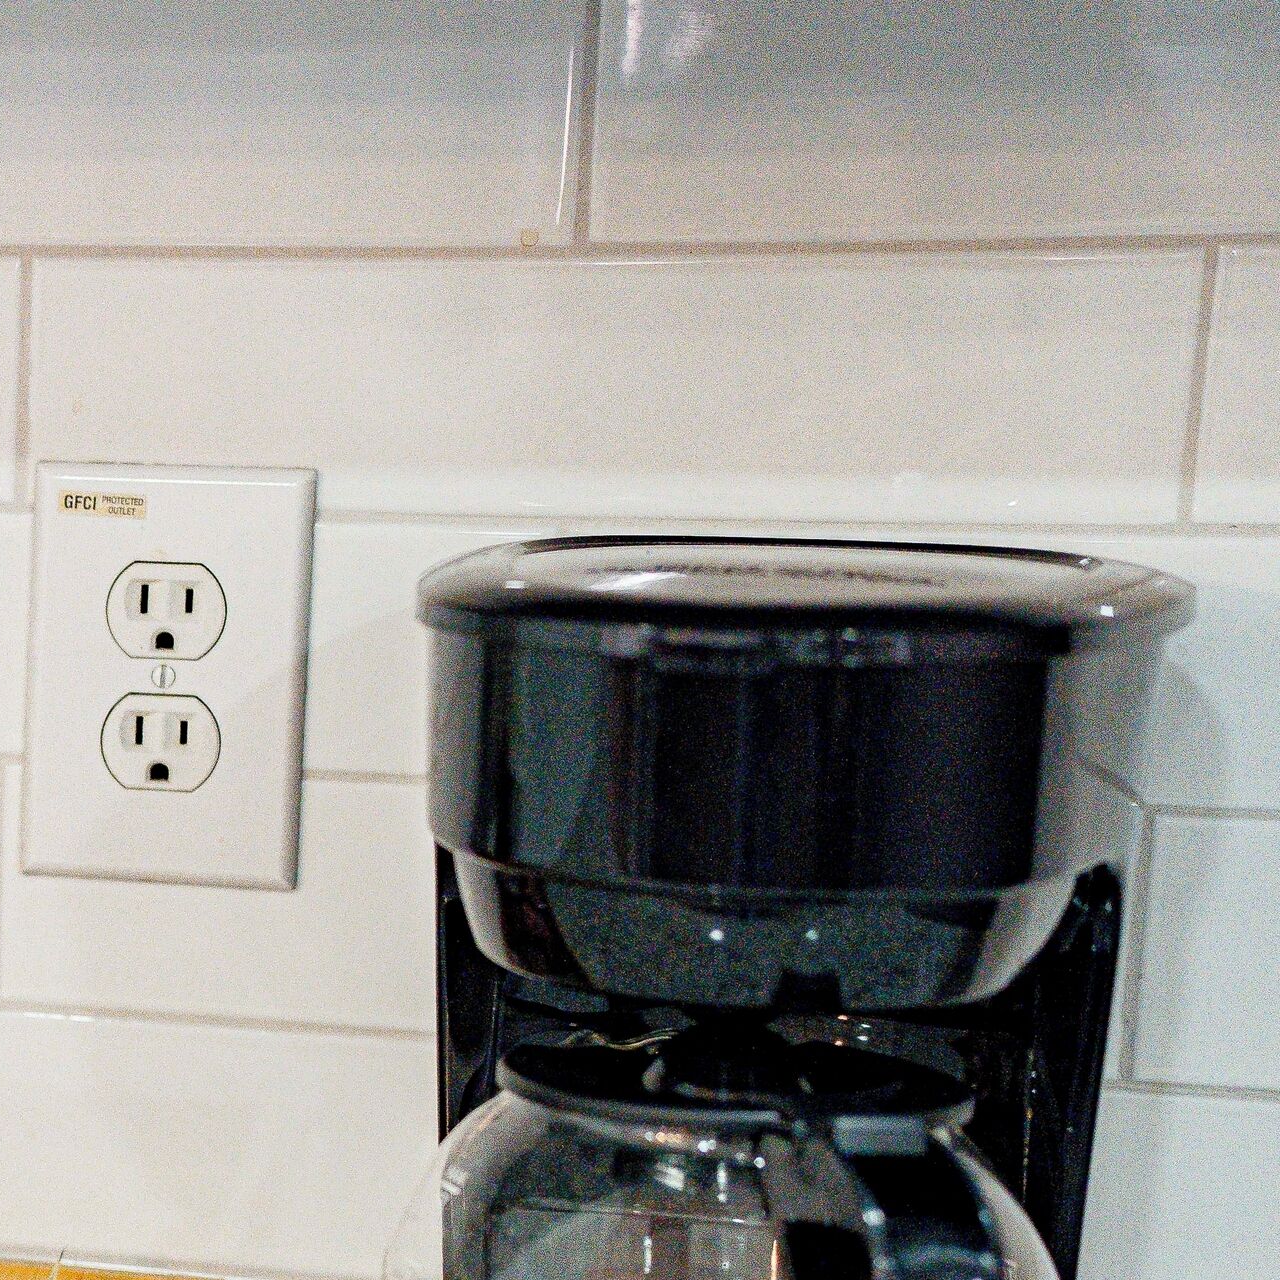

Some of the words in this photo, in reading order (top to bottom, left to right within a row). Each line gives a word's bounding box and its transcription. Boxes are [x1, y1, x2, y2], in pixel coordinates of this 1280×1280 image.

[64, 494, 97, 511] GFCI
[101, 495, 144, 506] PROTECTED
[107, 506, 136, 516] OUTLET
